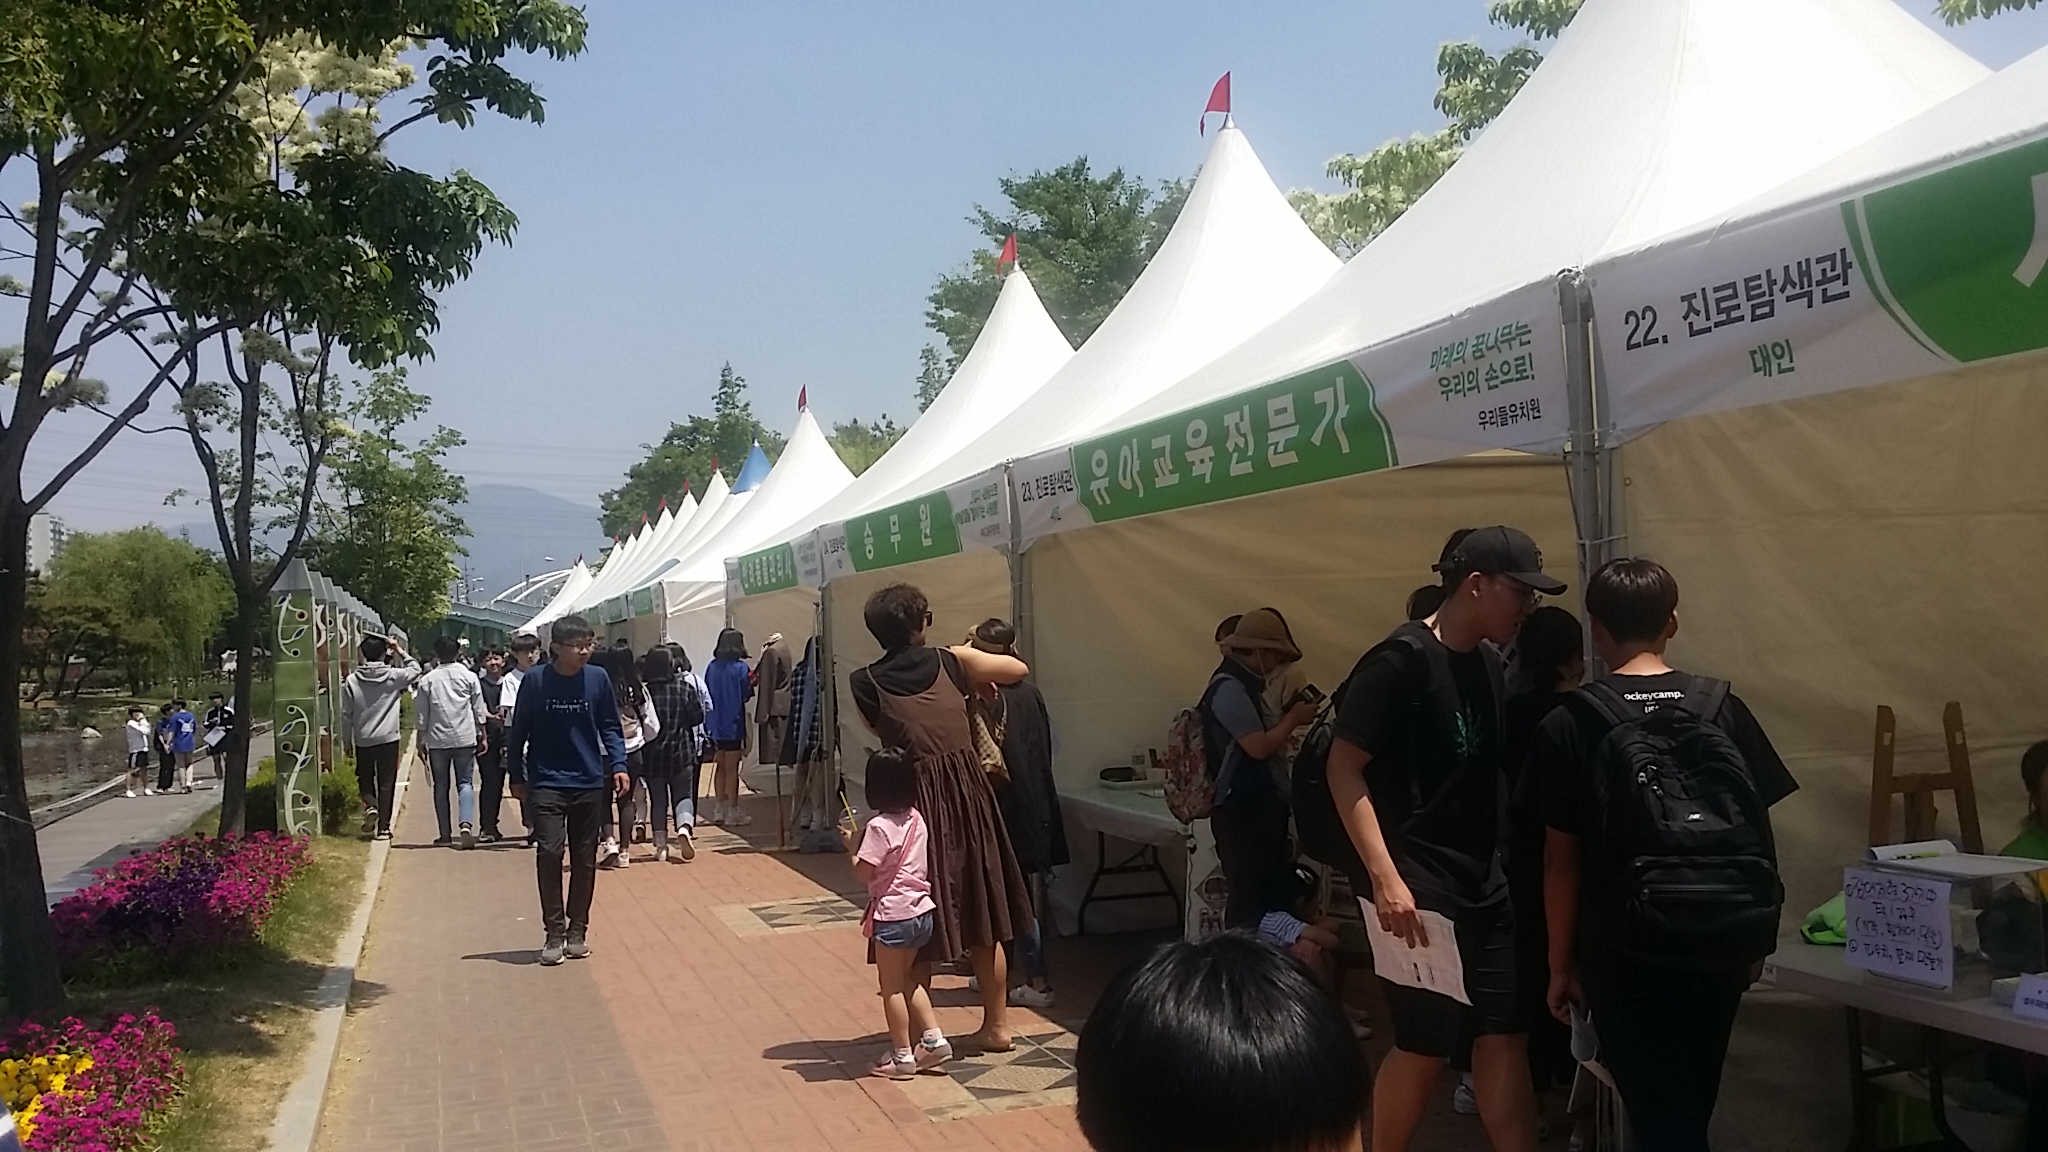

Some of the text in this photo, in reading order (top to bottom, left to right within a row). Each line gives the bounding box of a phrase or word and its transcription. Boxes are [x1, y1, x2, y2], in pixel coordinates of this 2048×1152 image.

[1623, 247, 1853, 352] 22. 진로탐색관
[1430, 321, 1532, 372] 미래의 꿈나무는
[1749, 338, 1795, 378] 대인
[1438, 353, 1535, 401] 우리의 손으로!
[1478, 398, 1541, 430] 우리들유치원
[1089, 376, 1351, 507] 유아교육전문가
[1021, 481, 1034, 502] 23.
[1035, 468, 1073, 499] 진로탐색관
[864, 503, 932, 561] 승무원
[1623, 691, 1685, 701] ockeycamp.
